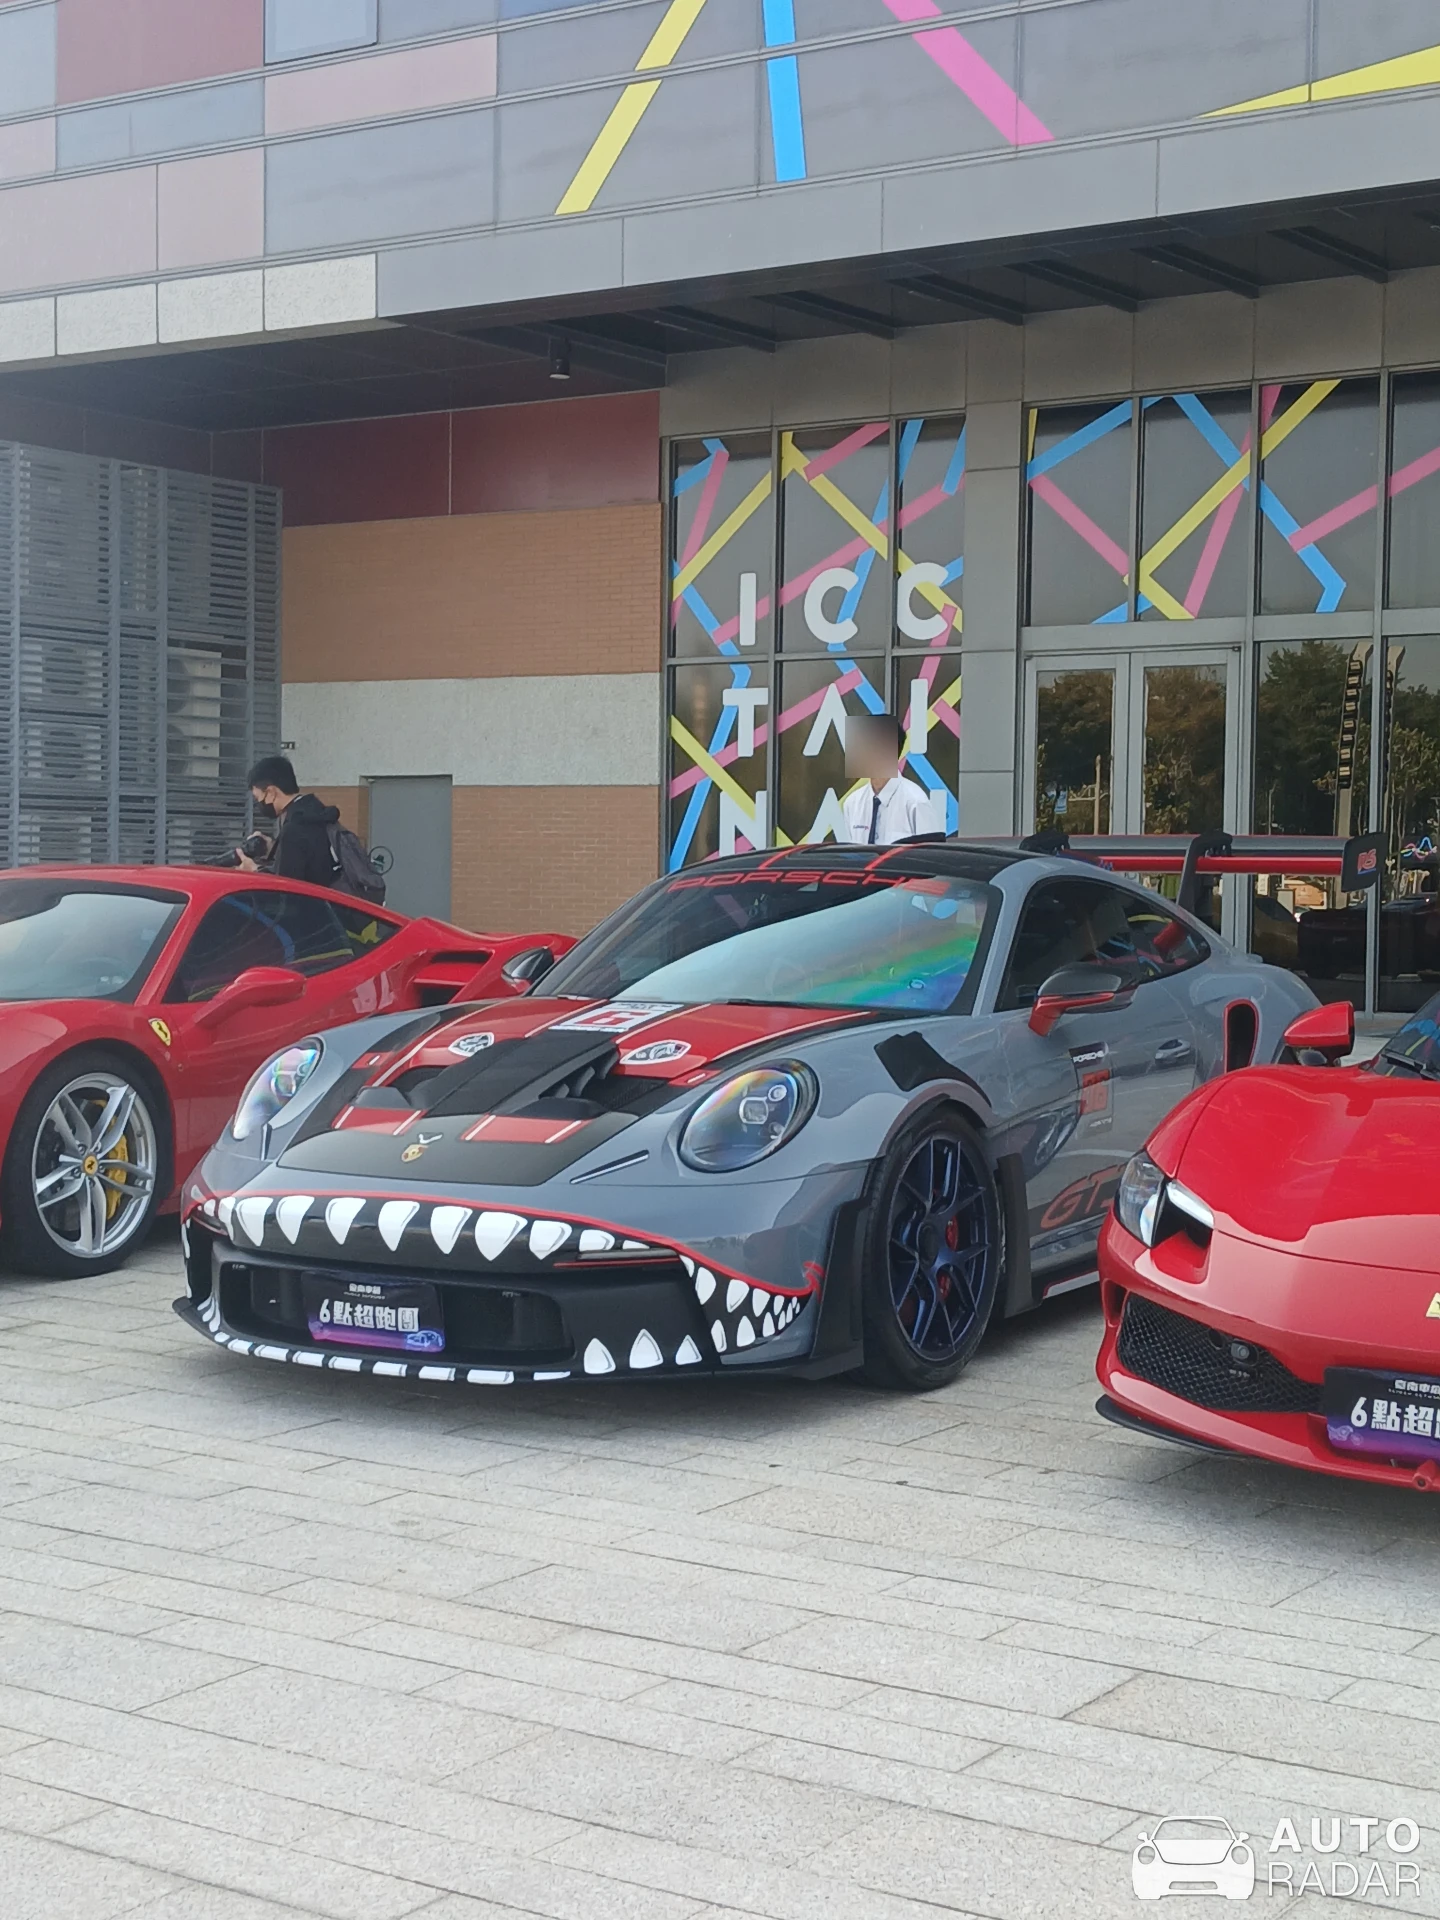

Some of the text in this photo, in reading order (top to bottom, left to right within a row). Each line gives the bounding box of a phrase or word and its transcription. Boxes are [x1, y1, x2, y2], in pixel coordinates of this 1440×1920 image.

[739, 562, 949, 646] ICC
[719, 786, 947, 857] NA
[667, 870, 951, 898] PORSCHE
[1040, 1162, 1126, 1230] GT
[319, 1298, 419, 1333] 6點超跑團
[1350, 1396, 1440, 1440] 6點超
